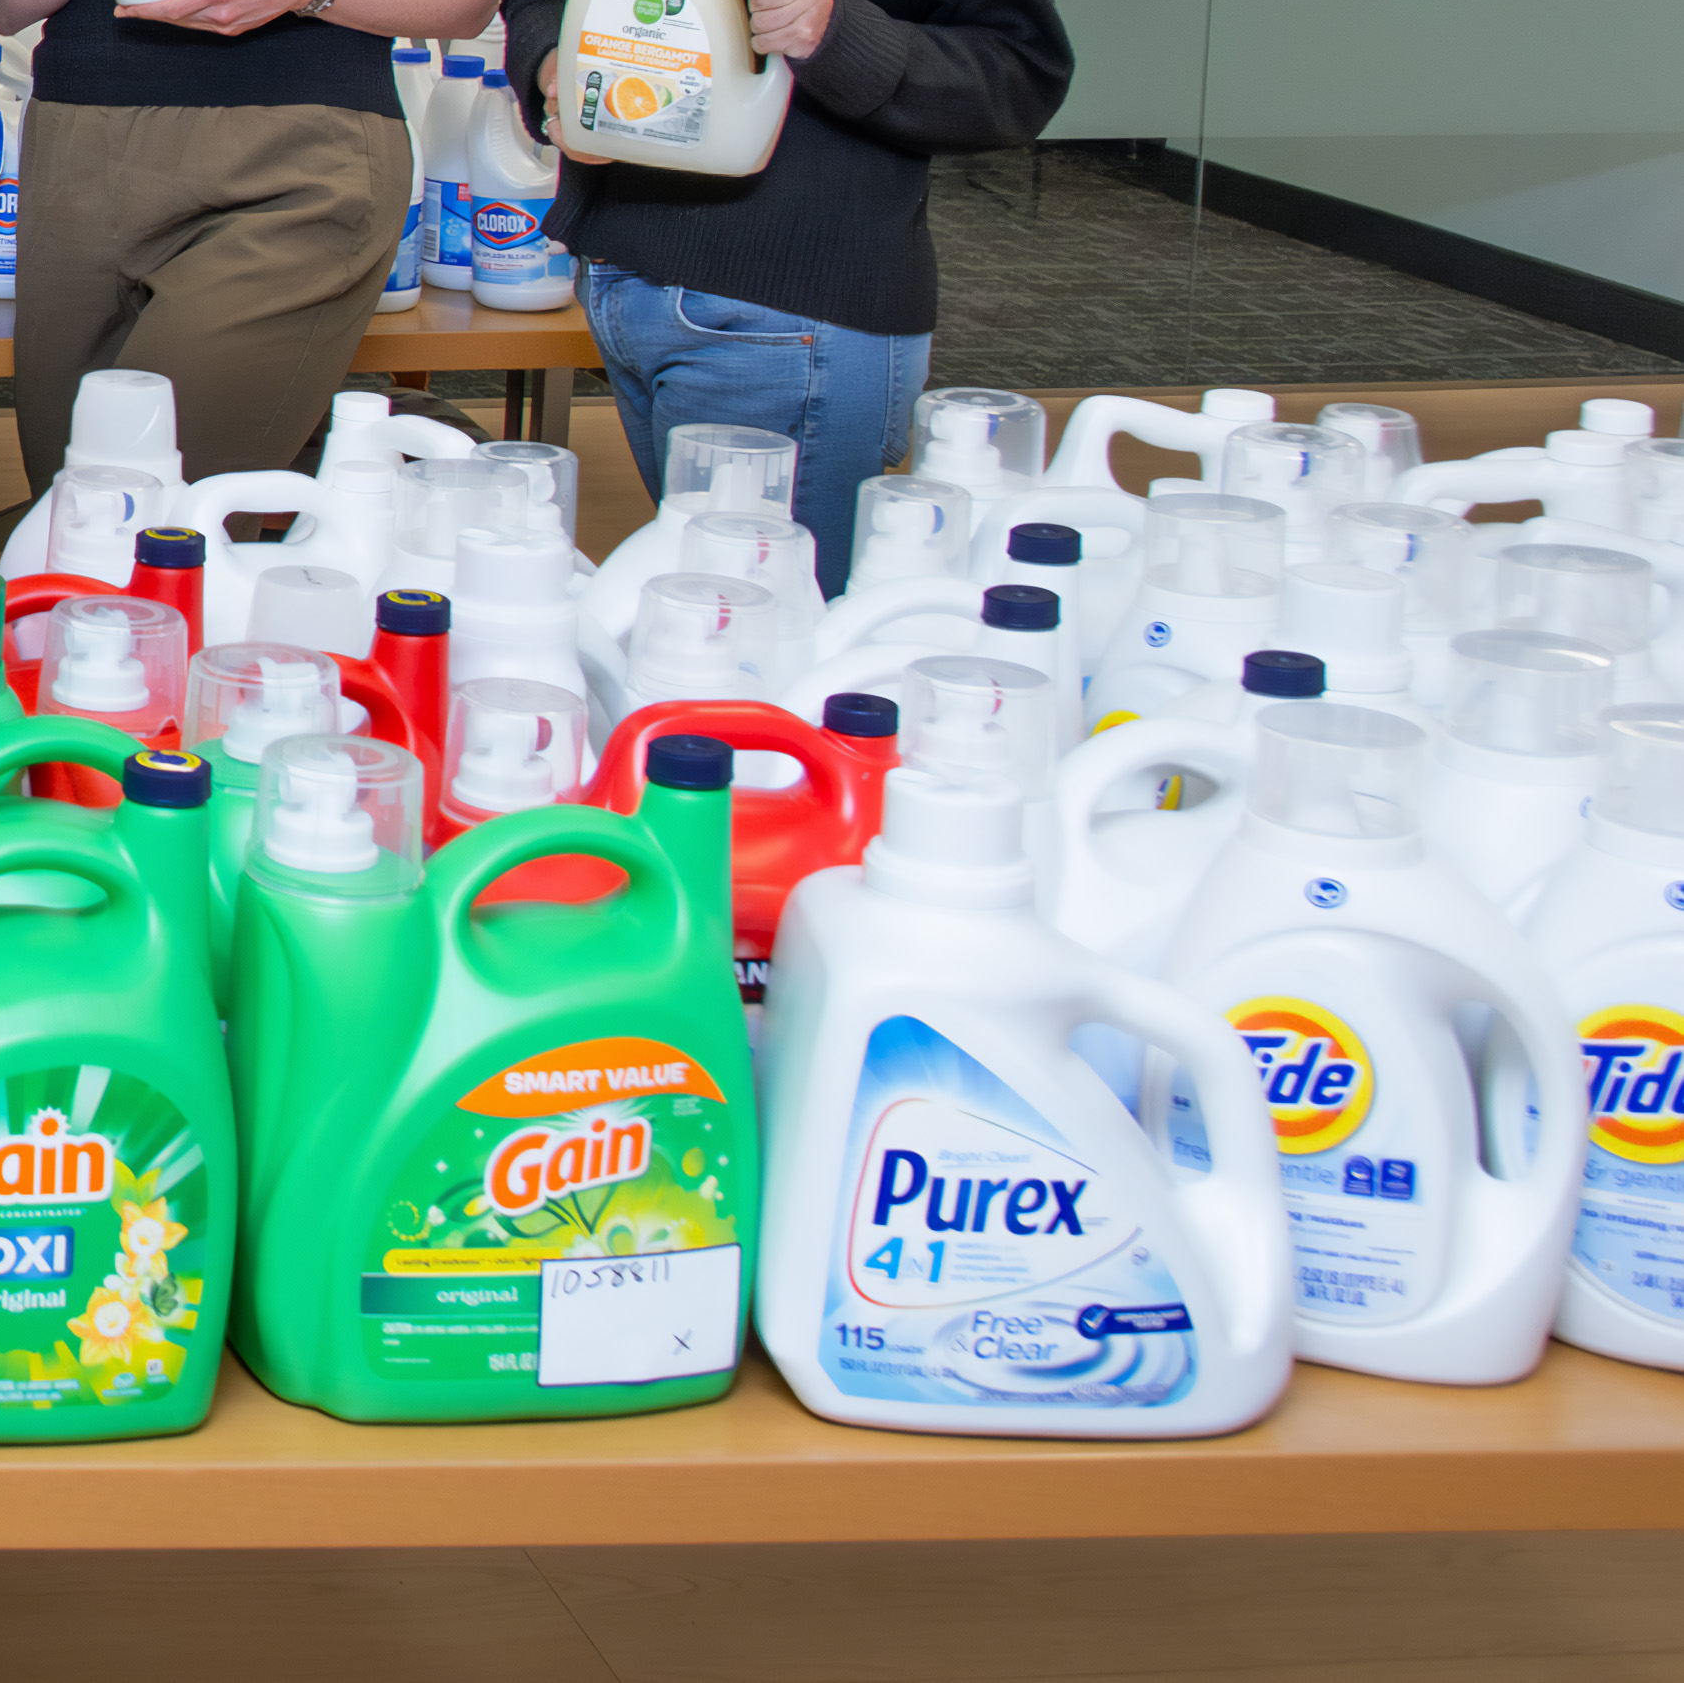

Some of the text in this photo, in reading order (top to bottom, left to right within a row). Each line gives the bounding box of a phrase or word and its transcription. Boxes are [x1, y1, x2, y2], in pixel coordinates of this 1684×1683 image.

[622, 25, 667, 40] organic
[584, 34, 699, 64] ORANGE BERGAMOT
[476, 212, 527, 234] CLOROX
[504, 1061, 691, 1095] SMART VALUE
[1581, 1043, 1684, 1115] Tid
[491, 1118, 645, 1210] Gain
[872, 1148, 1088, 1237] Purex
[863, 1236, 904, 1280] 4
[927, 1240, 946, 1283] 1
[436, 1286, 519, 1306] original
[972, 1310, 1045, 1336] Free
[835, 1324, 886, 1351] 115
[973, 1335, 1061, 1361] Clear
